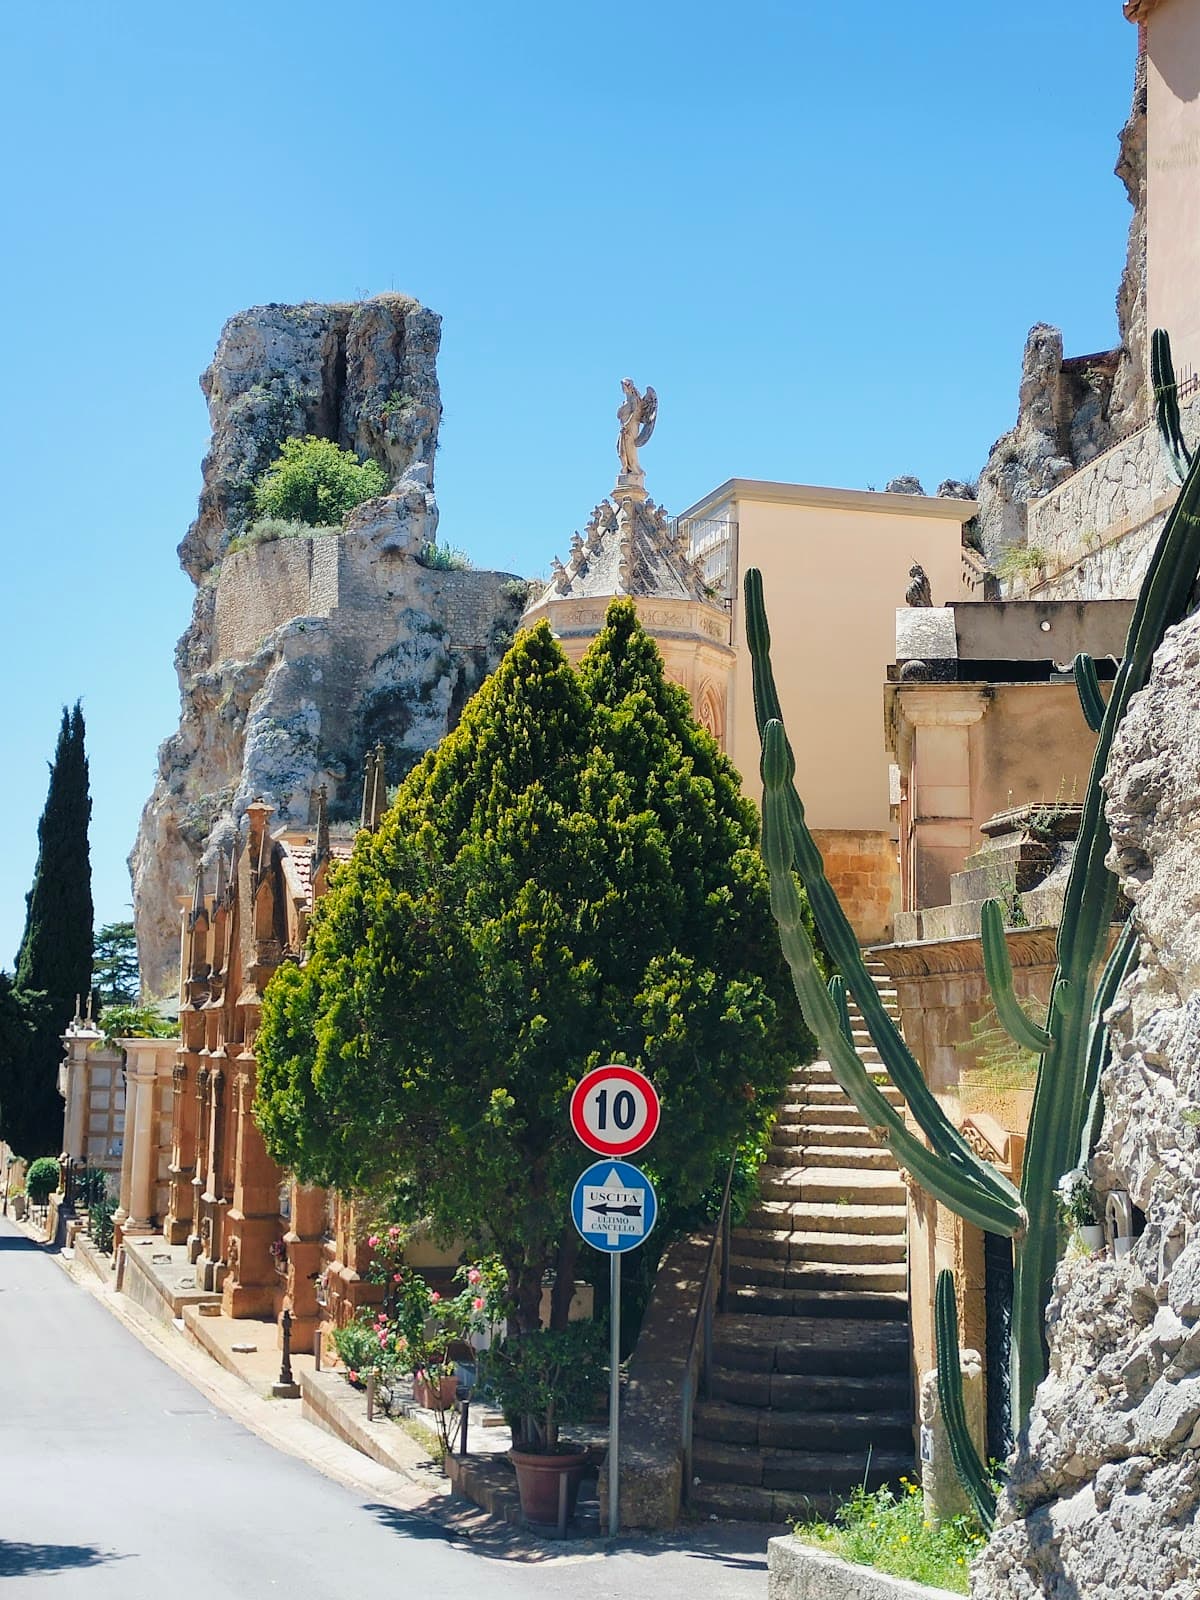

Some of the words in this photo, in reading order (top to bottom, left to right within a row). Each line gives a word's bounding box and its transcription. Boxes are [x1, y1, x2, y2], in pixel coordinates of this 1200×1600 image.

[595, 1089, 636, 1130] 10
[590, 1191, 638, 1203] USCITA
[597, 1216, 629, 1224] ULTIMO
[591, 1223, 635, 1232] CANCELLO
